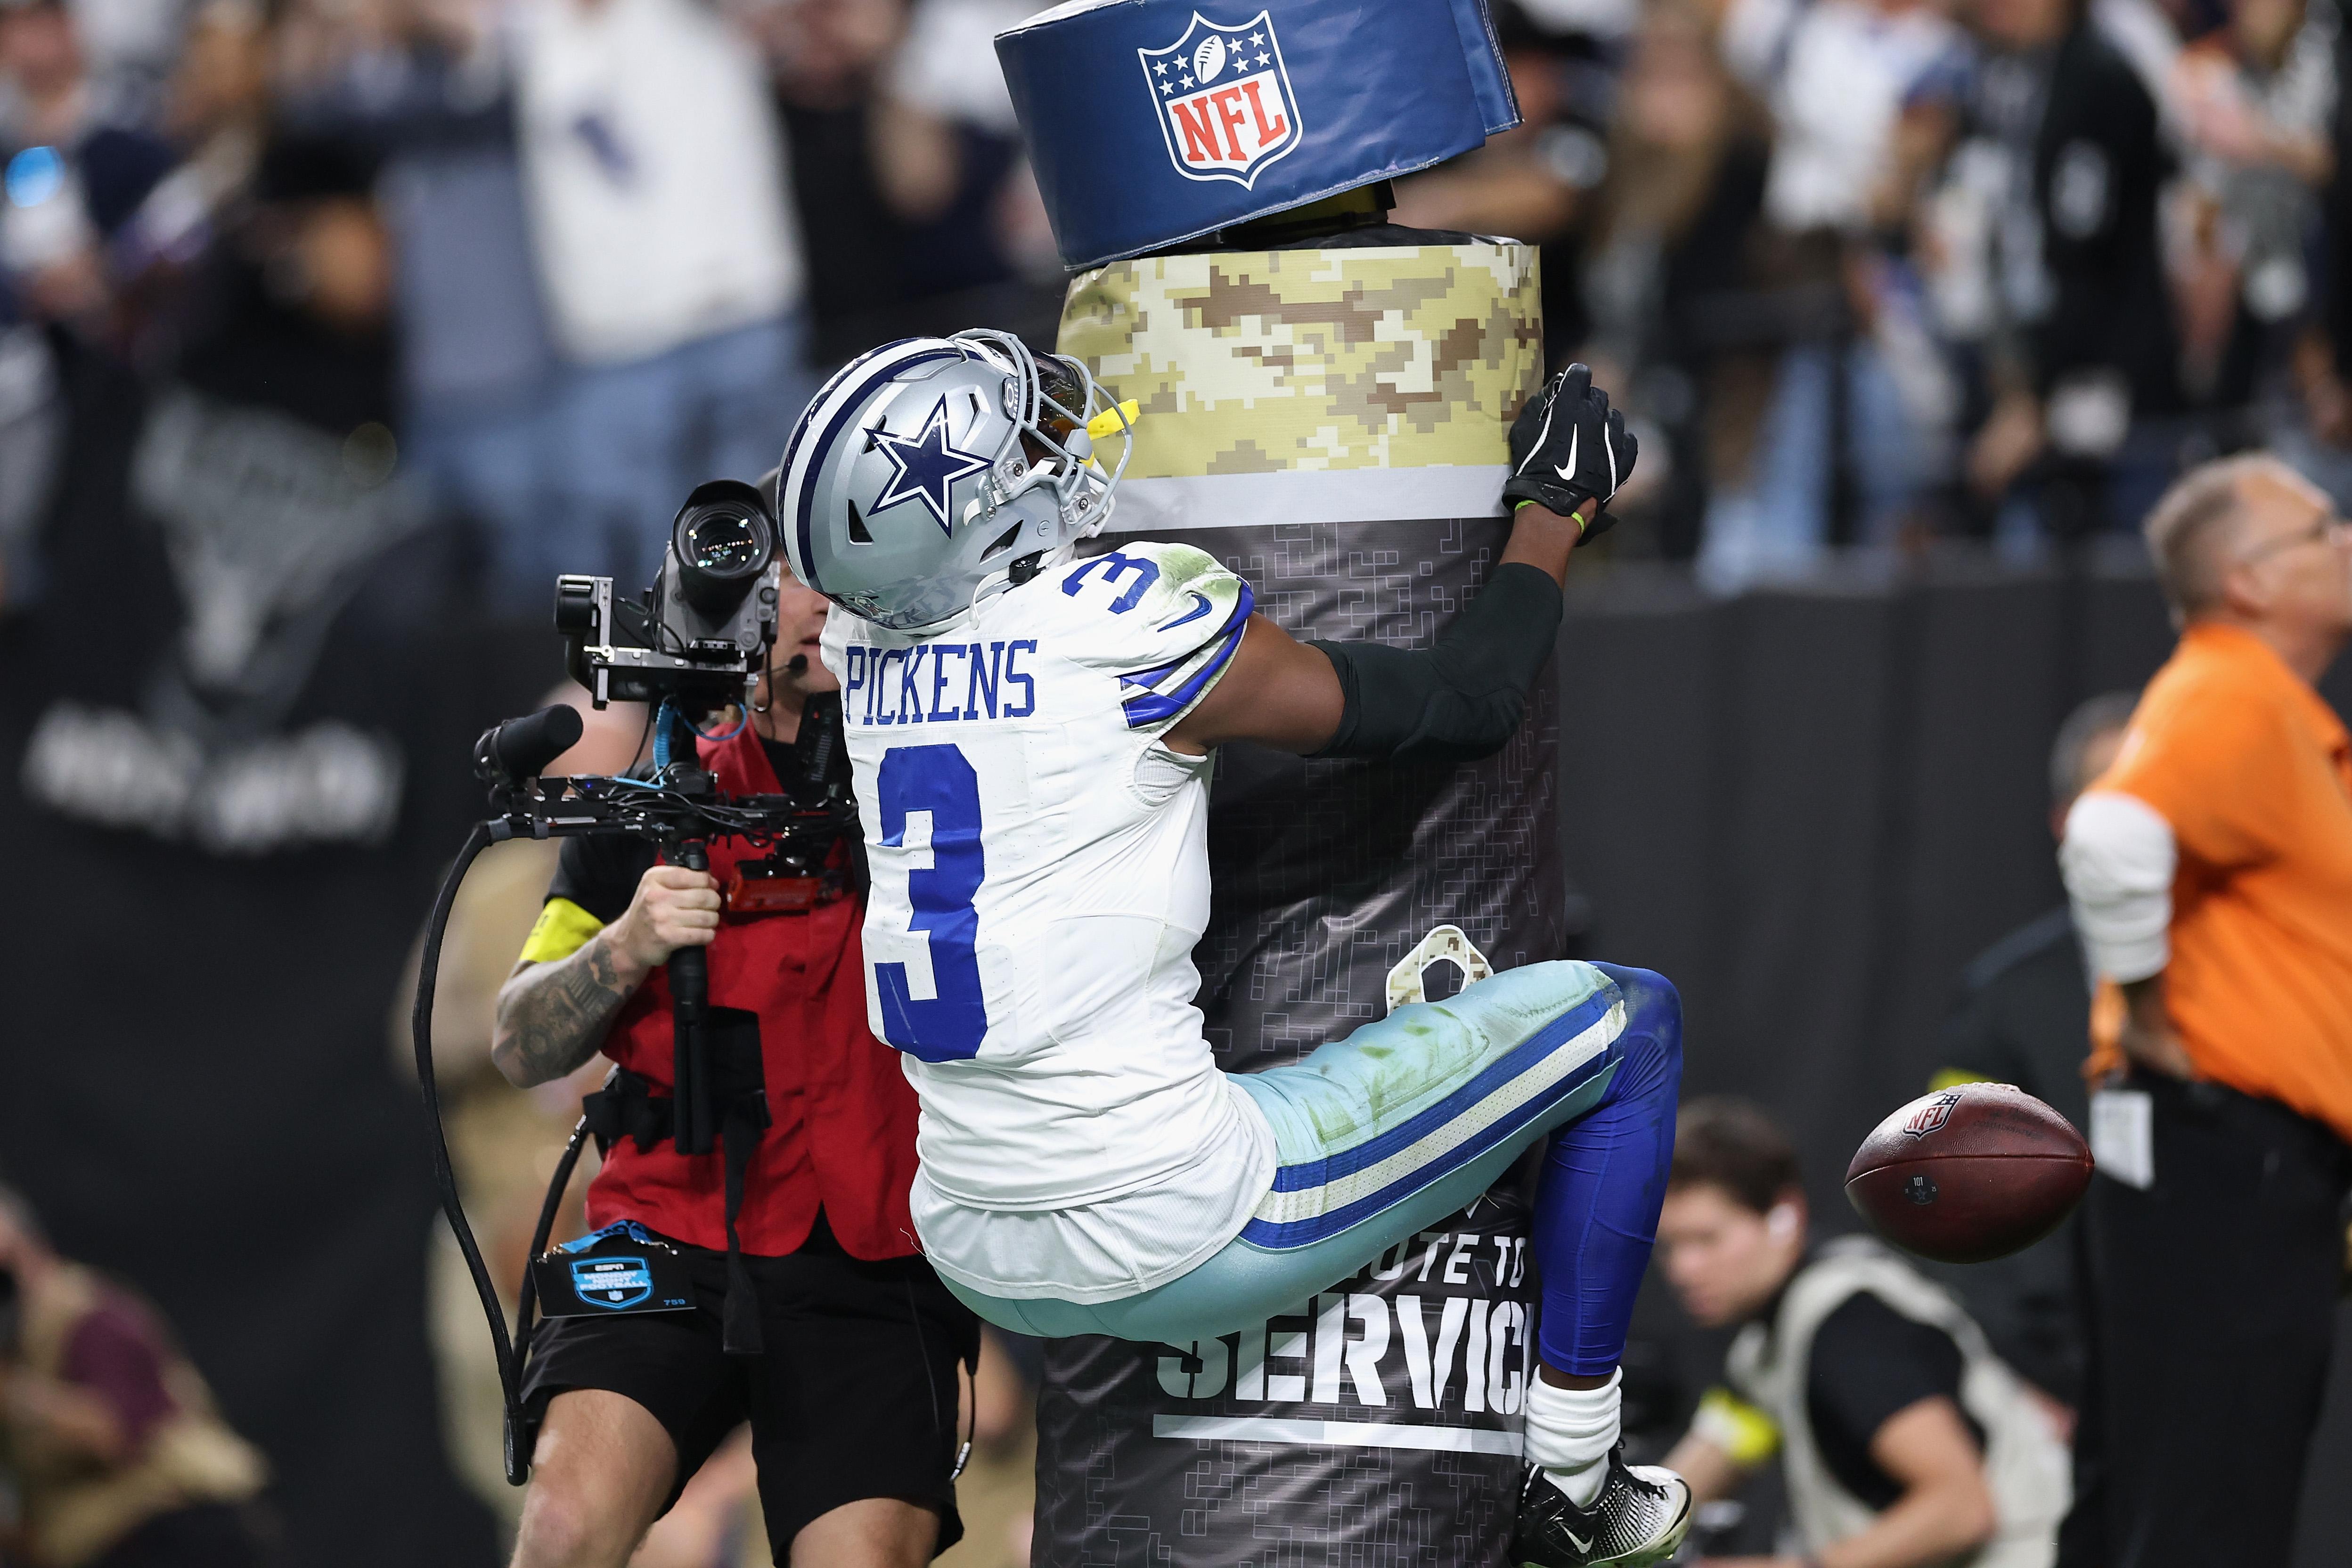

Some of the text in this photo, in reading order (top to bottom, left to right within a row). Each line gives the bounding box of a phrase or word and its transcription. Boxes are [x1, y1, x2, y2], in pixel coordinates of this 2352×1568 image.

[1172, 81, 1286, 162] NFL
[1062, 552, 1160, 615] 3
[846, 639, 1037, 726] PICKENS
[874, 743, 988, 1063] 3
[1906, 1106, 1945, 1131] NFL
[1913, 1176, 1923, 1186] 101
[1347, 1232, 1527, 1288] UTE TO
